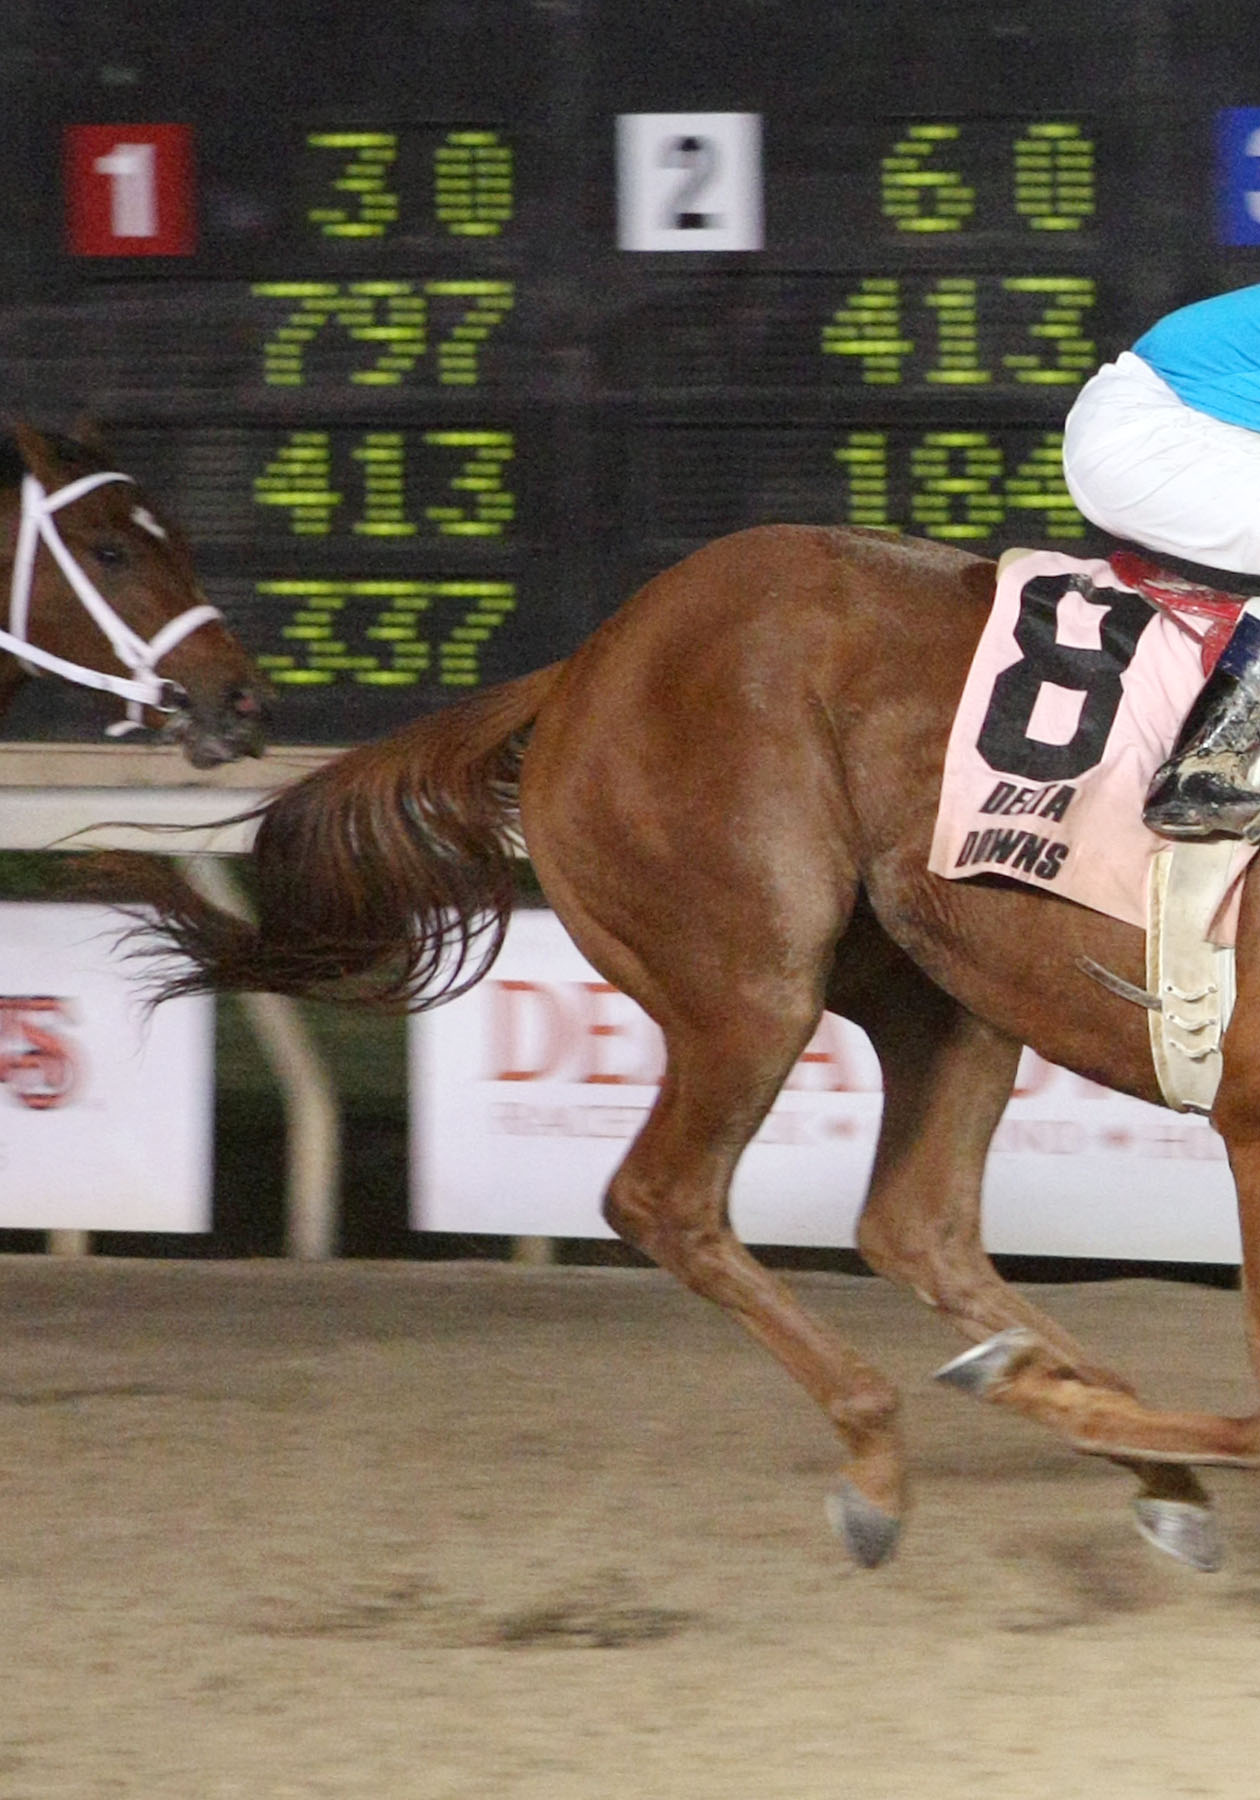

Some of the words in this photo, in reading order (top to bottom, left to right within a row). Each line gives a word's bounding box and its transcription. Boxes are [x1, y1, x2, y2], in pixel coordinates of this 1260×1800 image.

[94, 143, 157, 238] 1
[656, 135, 728, 230] 2
[252, 280, 513, 386] 797
[822, 277, 1096, 386] 413
[253, 430, 515, 538] 413
[256, 579, 516, 686] 337
[975, 573, 1162, 782] 8
[954, 828, 1070, 881] DOWNS
[978, 780, 1077, 823] DETA
